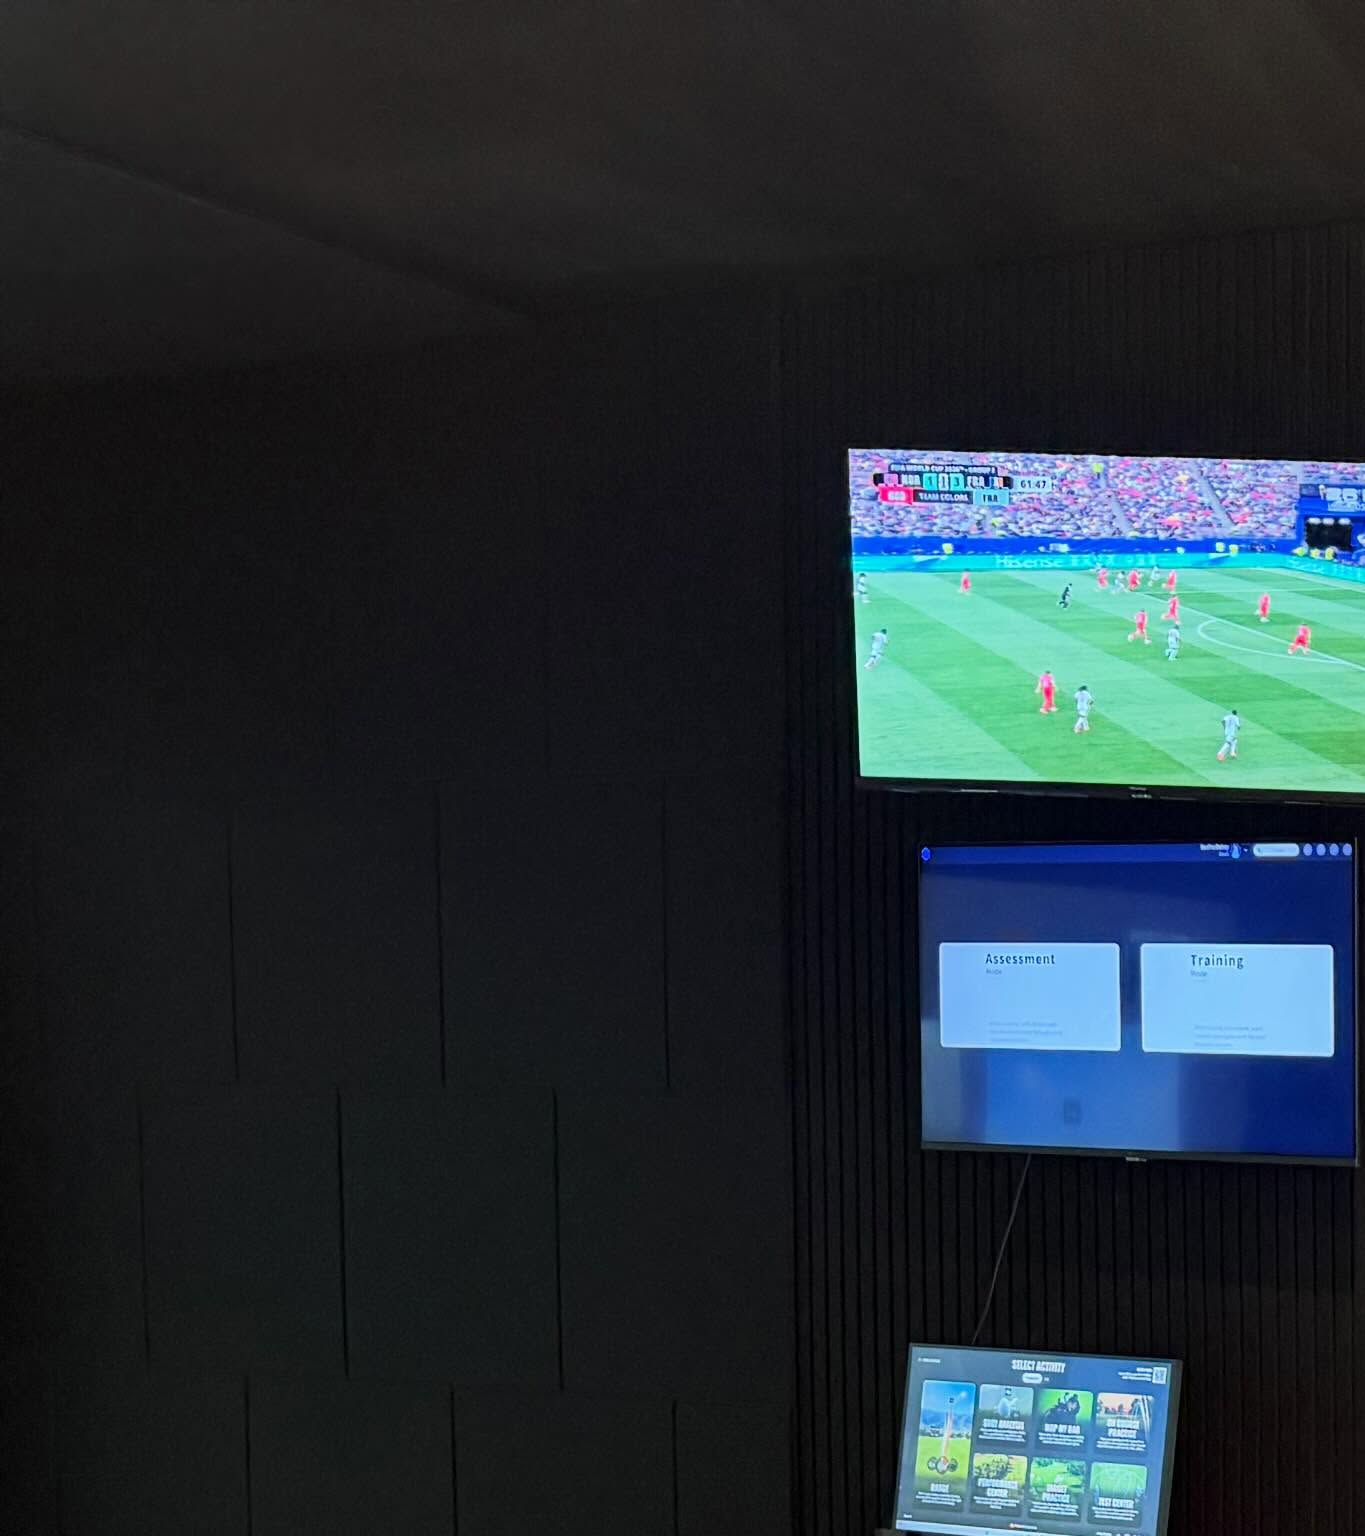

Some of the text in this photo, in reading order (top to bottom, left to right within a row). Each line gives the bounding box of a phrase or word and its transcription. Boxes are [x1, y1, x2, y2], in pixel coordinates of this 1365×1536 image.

[985, 953, 1056, 965] Assessment
[1190, 954, 1245, 970] Training
[1011, 1359, 1066, 1374] SELECT ACTIVITY
